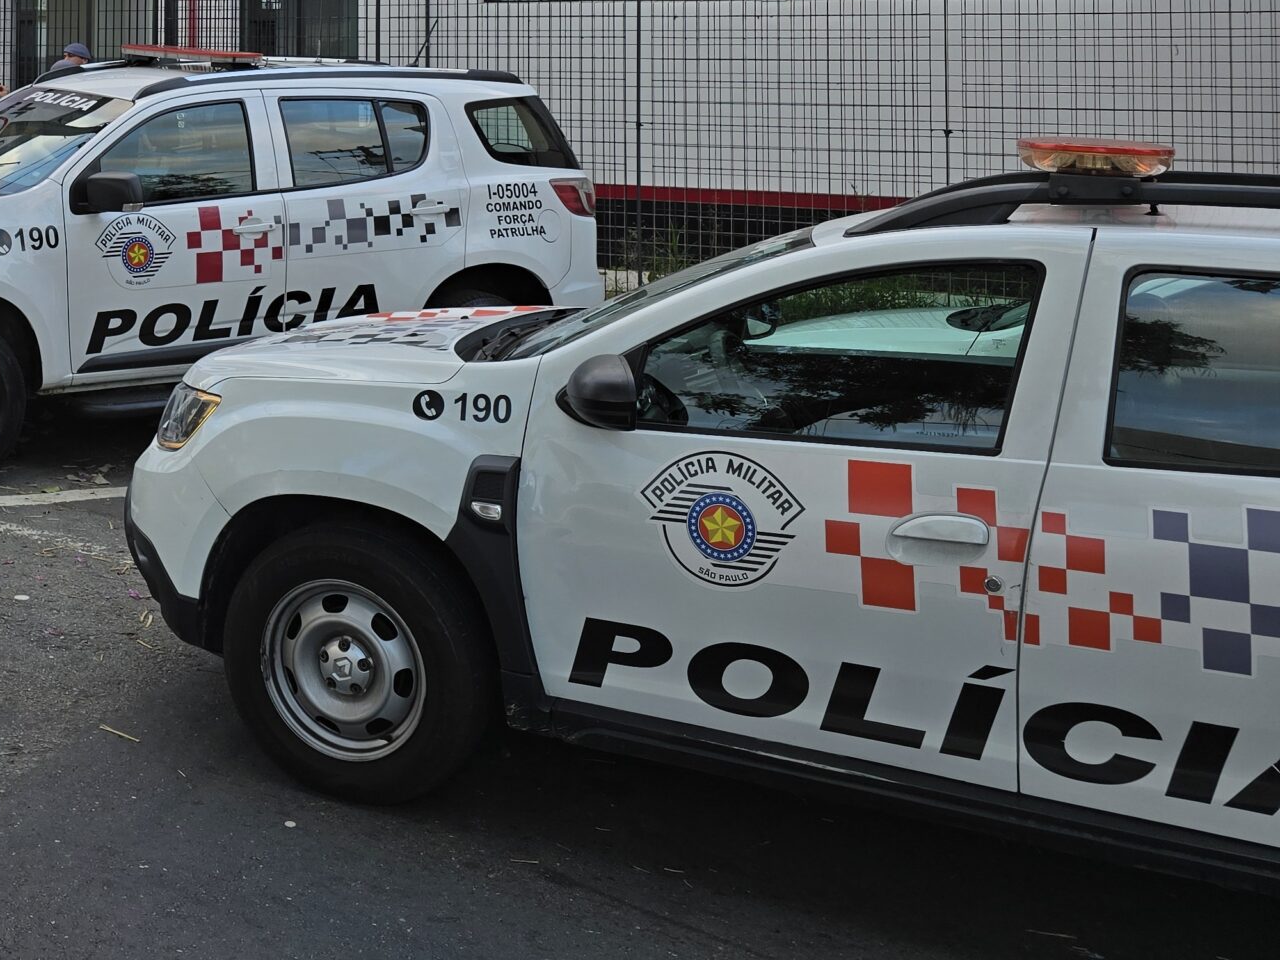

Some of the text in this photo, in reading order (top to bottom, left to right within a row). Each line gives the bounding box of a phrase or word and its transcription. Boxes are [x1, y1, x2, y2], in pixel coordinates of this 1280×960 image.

[24, 92, 98, 111] POLÍCIA
[487, 182, 538, 200] I-05004
[486, 199, 542, 213] COMANDO
[136, 215, 171, 243] MILITAR
[497, 213, 535, 226] FORÇA
[14, 225, 59, 252] 190
[489, 225, 546, 239] PATRULHA
[86, 283, 380, 355] POLÍCIA
[454, 392, 512, 424] 190
[651, 456, 794, 516] POLÍCIA MILITAR
[698, 566, 749, 582] SÃO PAULO
